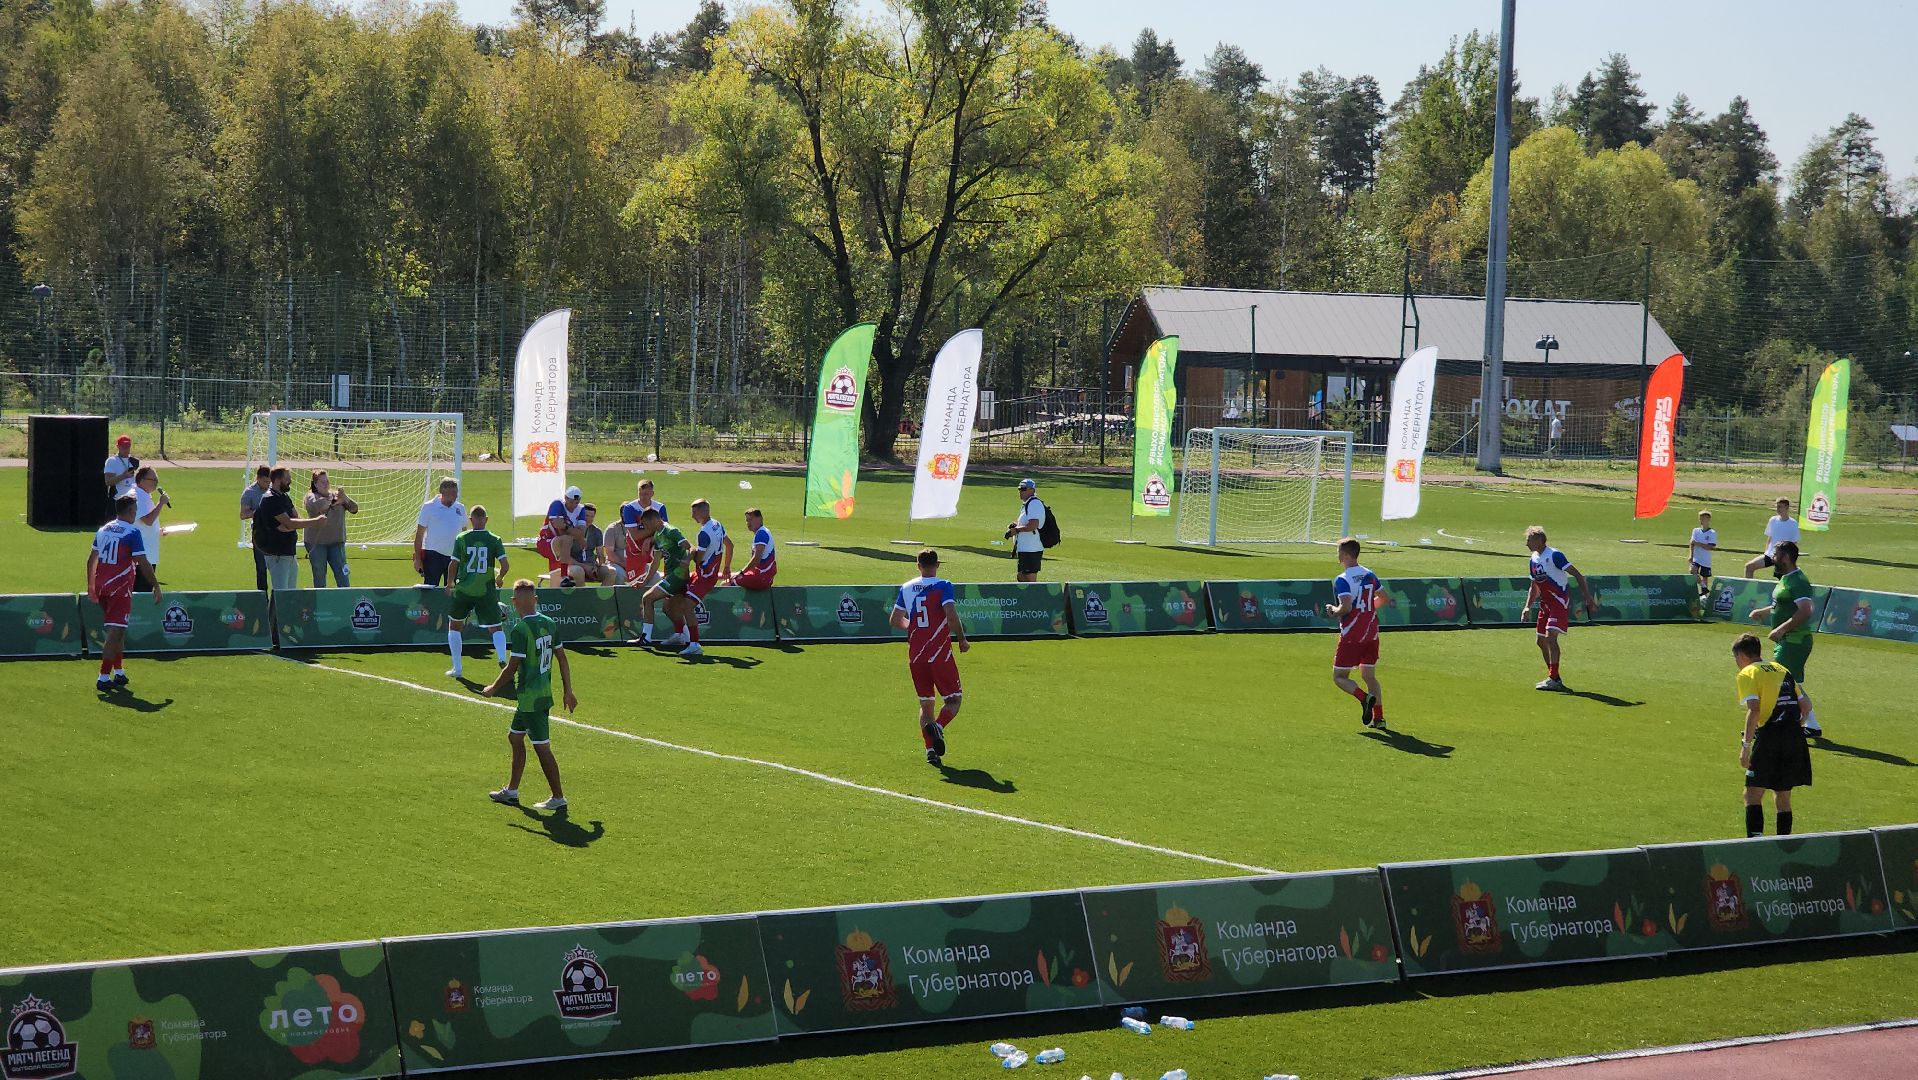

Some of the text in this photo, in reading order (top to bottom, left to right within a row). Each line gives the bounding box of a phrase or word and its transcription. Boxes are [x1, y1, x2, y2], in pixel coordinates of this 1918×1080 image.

[546, 357, 558, 433] Губернатора
[955, 366, 972, 444] ГУБЕРНАТОРА
[531, 381, 545, 434] Команда
[941, 386, 957, 443] КОМАНДА
[1411, 380, 1425, 451] ГУБЕРНАТОРА
[1471, 398, 1571, 420] ПОКАТ
[1402, 398, 1412, 450] КОМАНДА
[99, 535, 120, 565] 40
[466, 546, 488, 573] 28
[1355, 584, 1374, 613] 47
[915, 596, 929, 628] 5
[1750, 875, 1813, 893] Команда
[1505, 895, 1577, 913] Команда
[1755, 898, 1846, 922] Губернатора
[1216, 919, 1298, 940] Команда
[1510, 919, 1613, 943] Губернатора
[902, 944, 990, 965] Команда
[1222, 944, 1338, 971] Губернатора
[675, 970, 717, 983] лето
[908, 969, 1035, 998] Губернатора
[473, 984, 514, 996] Команда
[475, 995, 534, 1008] Губернатора
[562, 992, 613, 1006] МАТЧ ЛЕГЕНД
[161, 1018, 206, 1030] Команда
[269, 1004, 358, 1030] лето
[161, 1030, 227, 1046] Губернатора
[7, 1048, 71, 1066] МАТЧ ЛЕГЕНД
